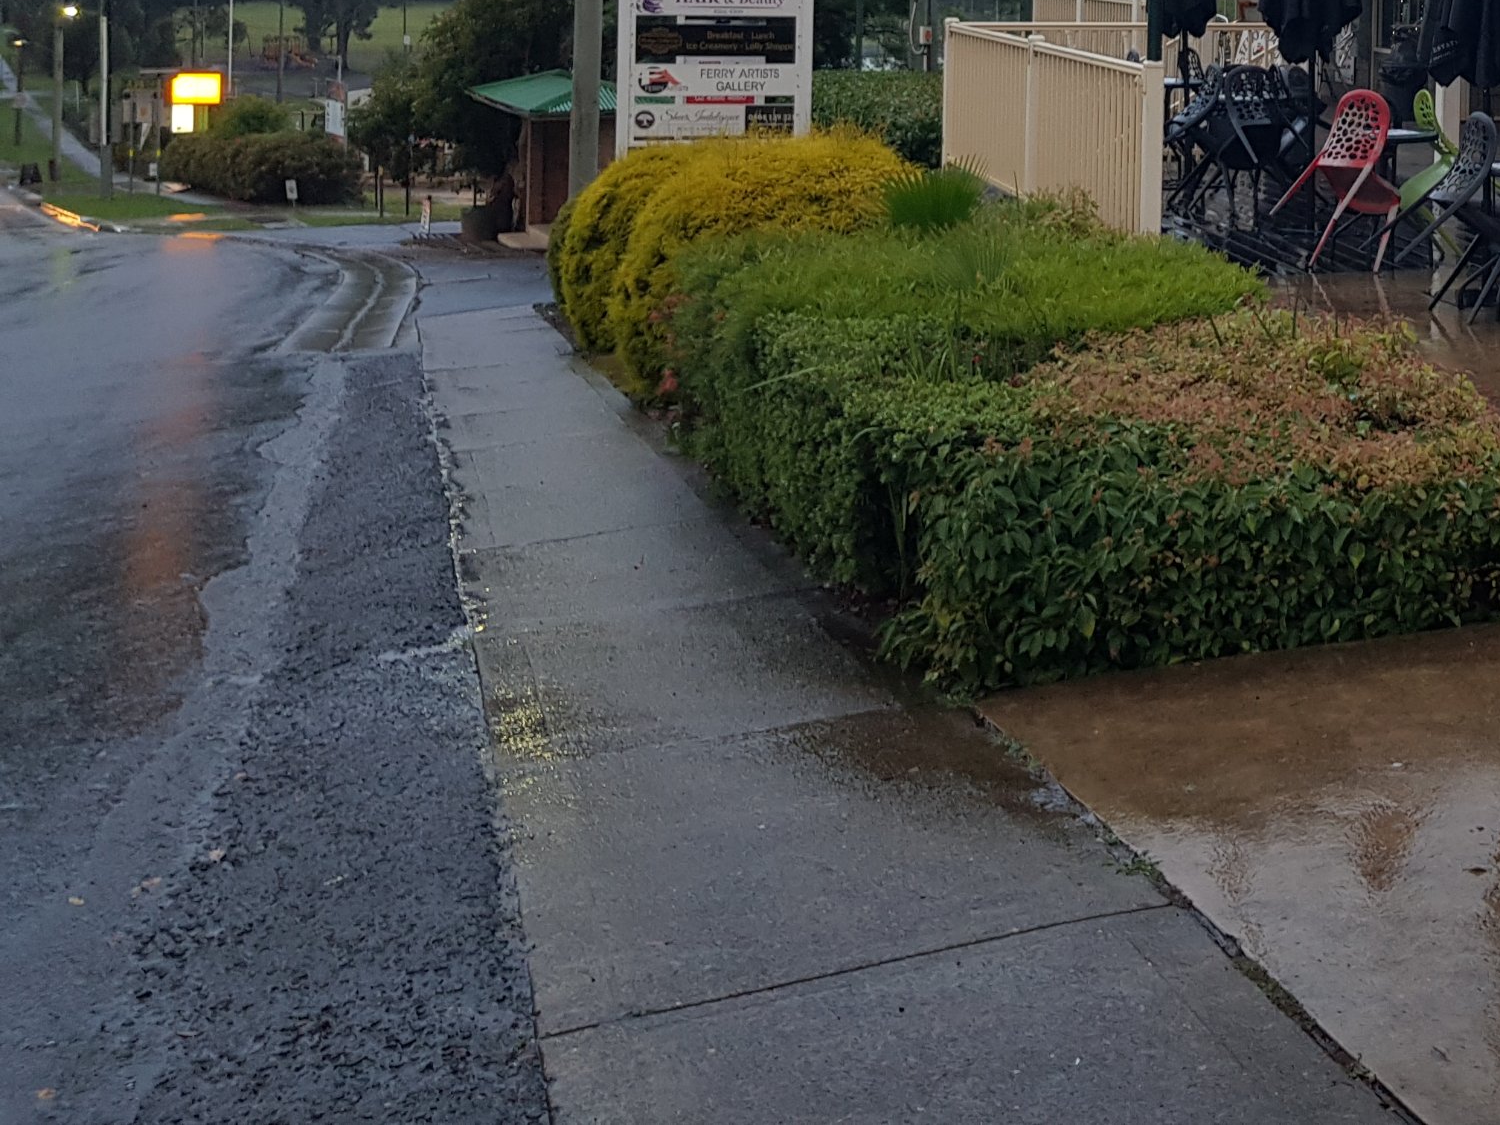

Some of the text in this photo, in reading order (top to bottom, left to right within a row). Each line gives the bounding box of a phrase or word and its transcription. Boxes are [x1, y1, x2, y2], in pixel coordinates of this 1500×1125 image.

[707, 31, 775, 40] Breakfast Lunch
[686, 42, 697, 51] Ice
[700, 42, 739, 53] Creamery
[745, 42, 764, 52] Lolly
[700, 68, 780, 79] FERRY ARTISTS
[716, 81, 766, 92] GALLERY
